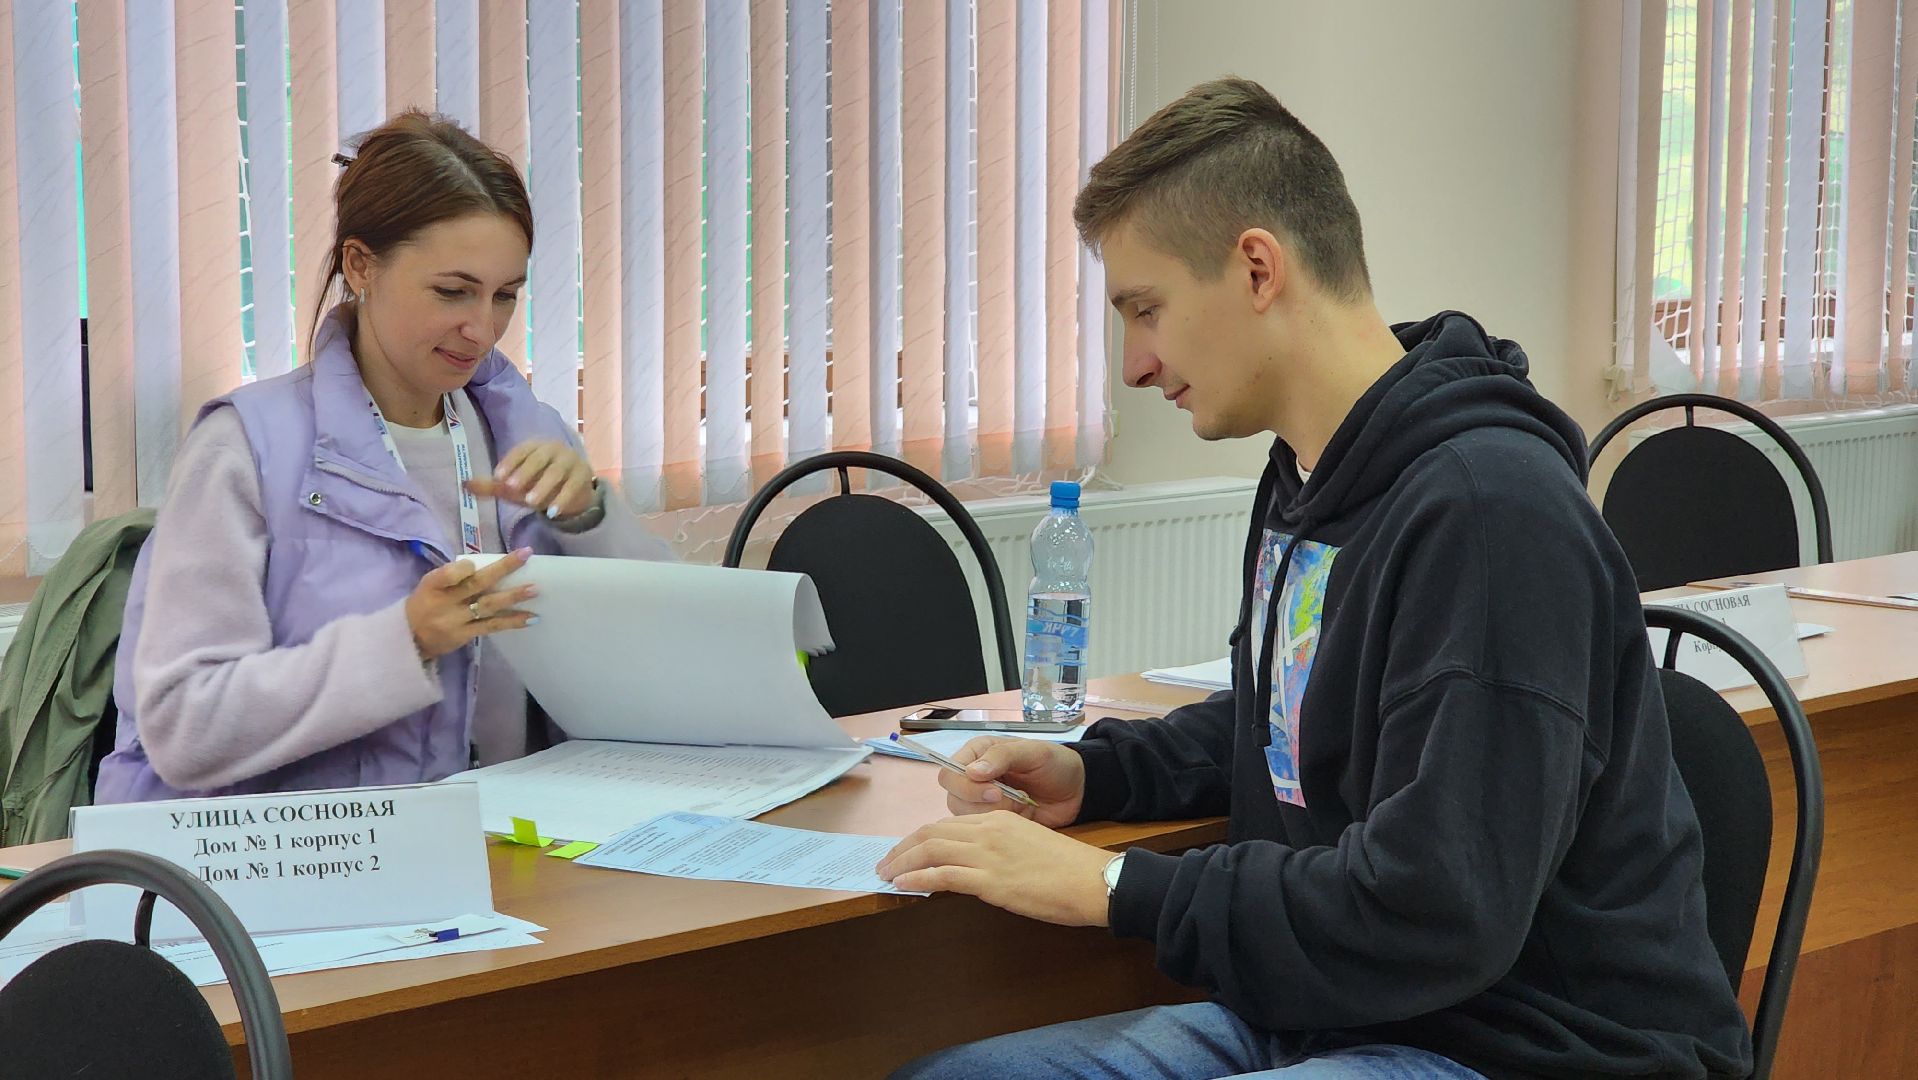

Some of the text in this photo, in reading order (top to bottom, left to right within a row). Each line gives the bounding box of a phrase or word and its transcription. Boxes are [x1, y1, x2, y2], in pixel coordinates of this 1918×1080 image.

[1694, 594, 1751, 613] СОСНОВАЯ
[170, 800, 396, 830] УЛИЦА СОСНОВАЯ
[193, 827, 376, 859] Дом № 1 корпус 1
[199, 855, 381, 885] Дом № 1 корпус 2
